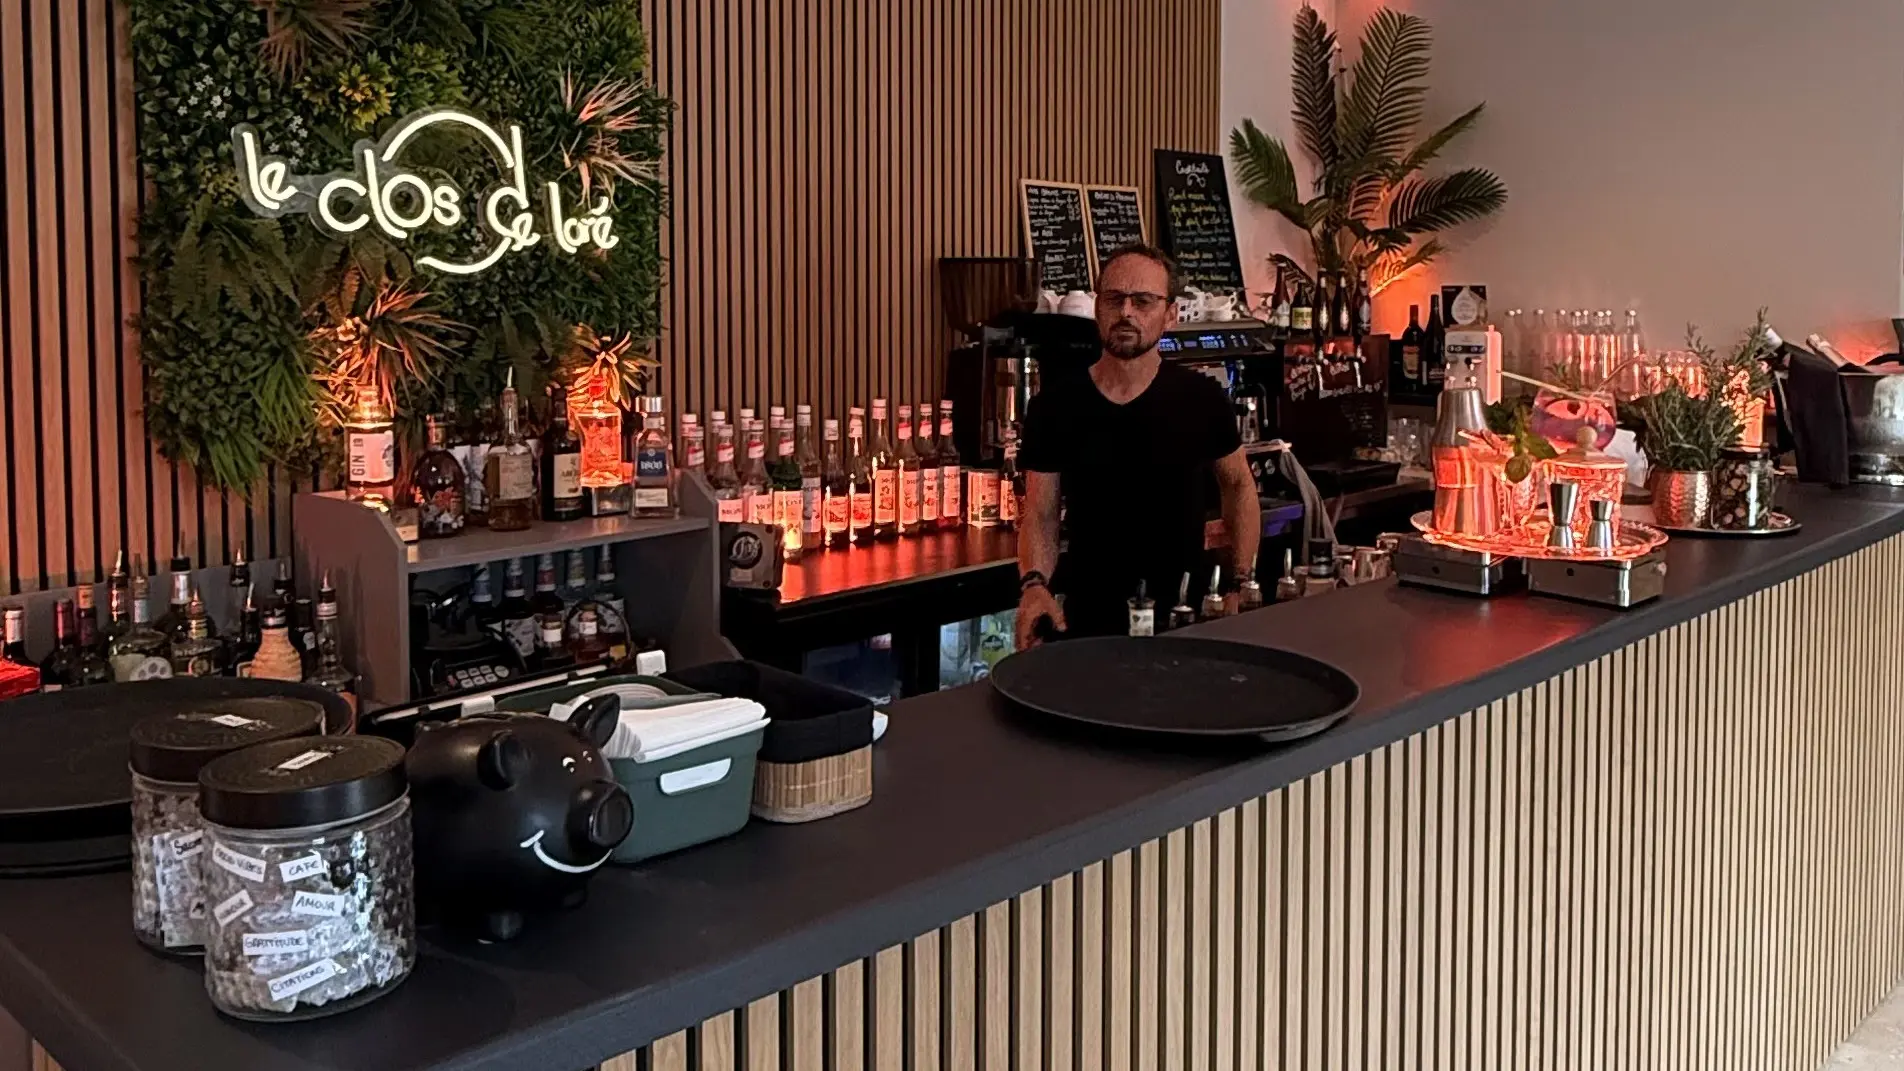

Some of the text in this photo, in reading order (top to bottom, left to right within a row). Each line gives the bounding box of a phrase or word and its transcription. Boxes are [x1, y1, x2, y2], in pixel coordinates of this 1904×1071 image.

[242, 131, 298, 210] le
[318, 148, 461, 239] clos
[351, 454, 366, 476] GIN
[295, 896, 337, 912] AMOUR
